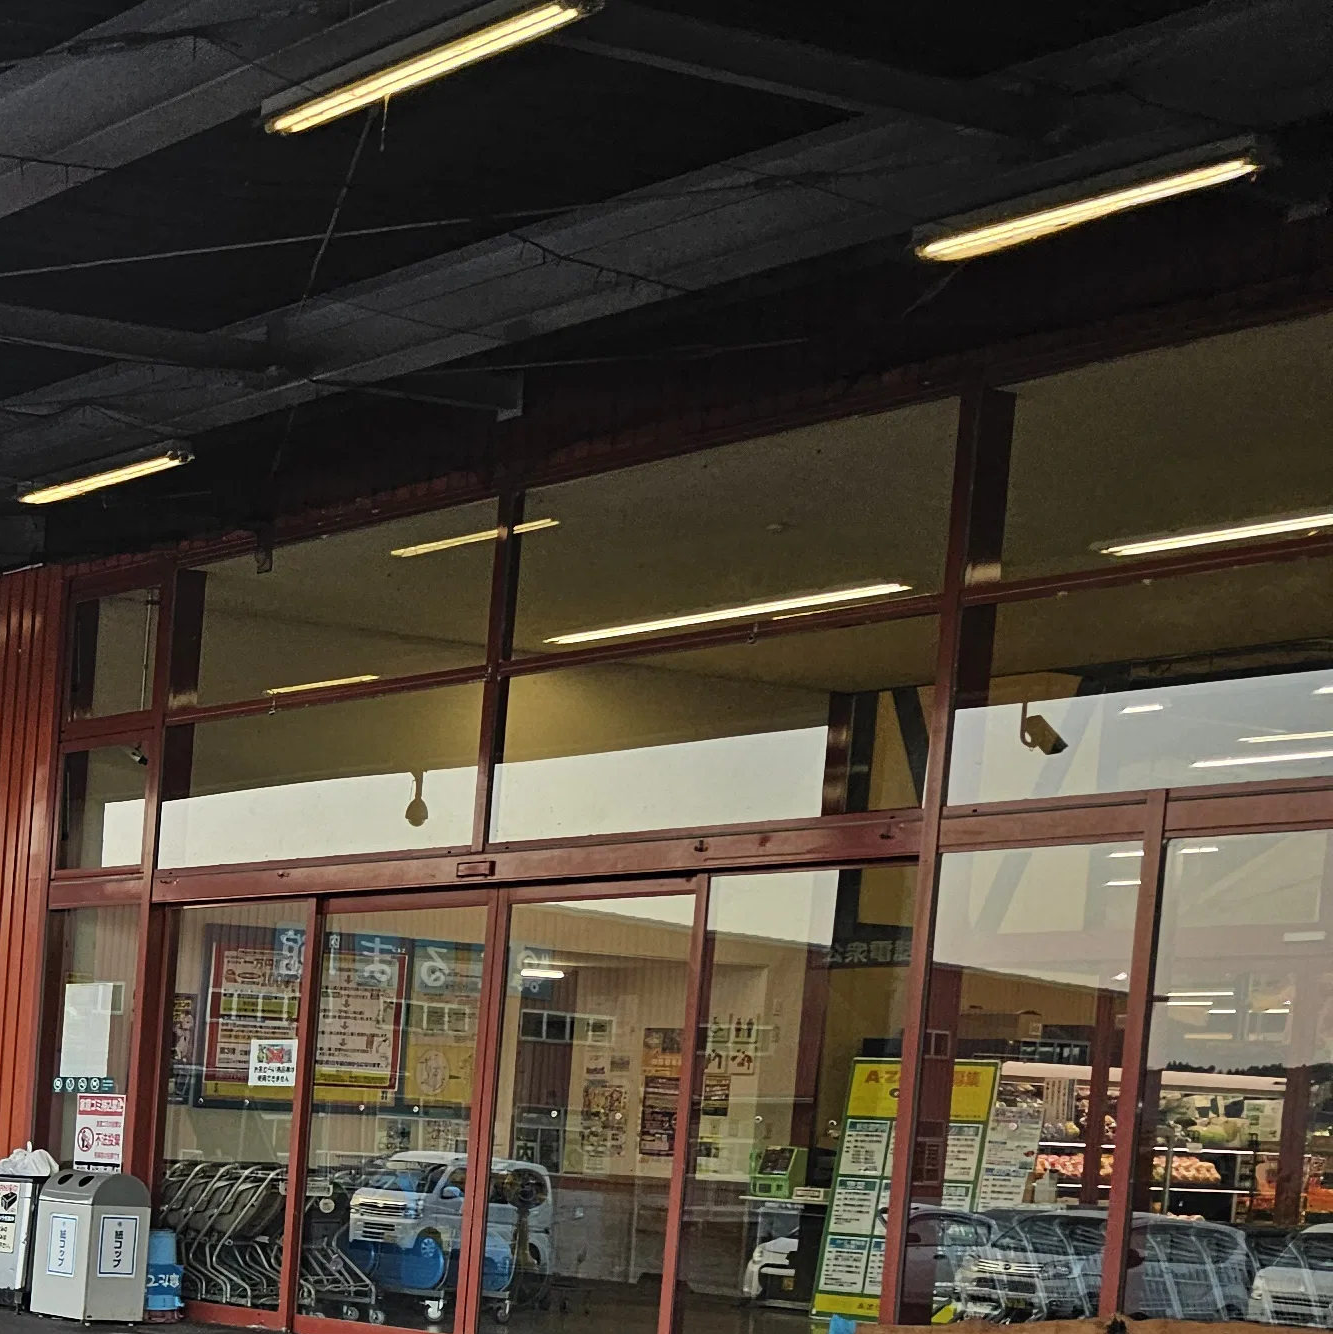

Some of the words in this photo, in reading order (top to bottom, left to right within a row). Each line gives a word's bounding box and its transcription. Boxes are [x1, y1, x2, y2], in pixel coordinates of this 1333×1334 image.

[58, 1229, 67, 1267] 紙コップ
[112, 1230, 124, 1269] 紙コップ
